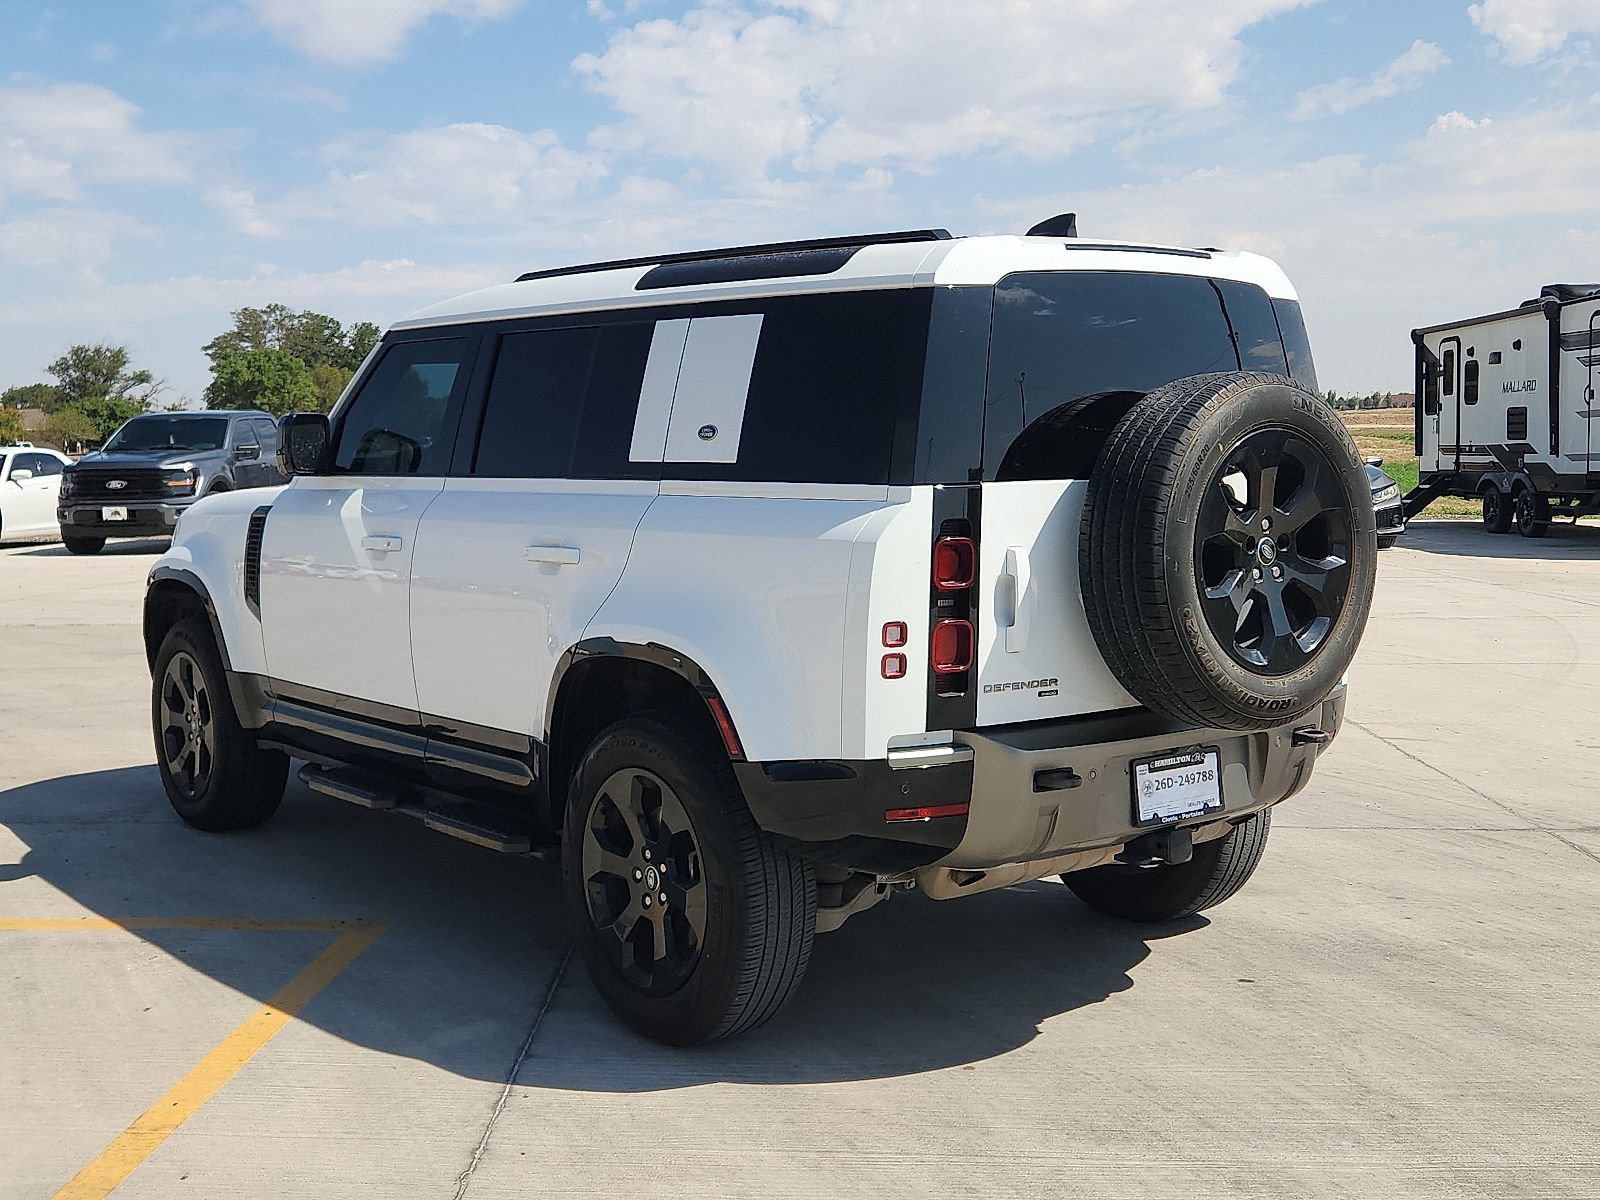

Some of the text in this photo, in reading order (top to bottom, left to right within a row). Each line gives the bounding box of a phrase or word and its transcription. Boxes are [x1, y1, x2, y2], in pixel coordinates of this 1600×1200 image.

[1502, 379, 1537, 394] MALLARD
[1300, 397, 1356, 455] NEXEN
[1185, 443, 1212, 499] 255/60R20
[983, 678, 1059, 694] DEFENDER
[1222, 678, 1298, 711] ROADIAN
[1154, 754, 1191, 768] HAMILTON
[1154, 770, 1214, 791] 26D-249788
[1161, 810, 1205, 824] Clovis Portales
